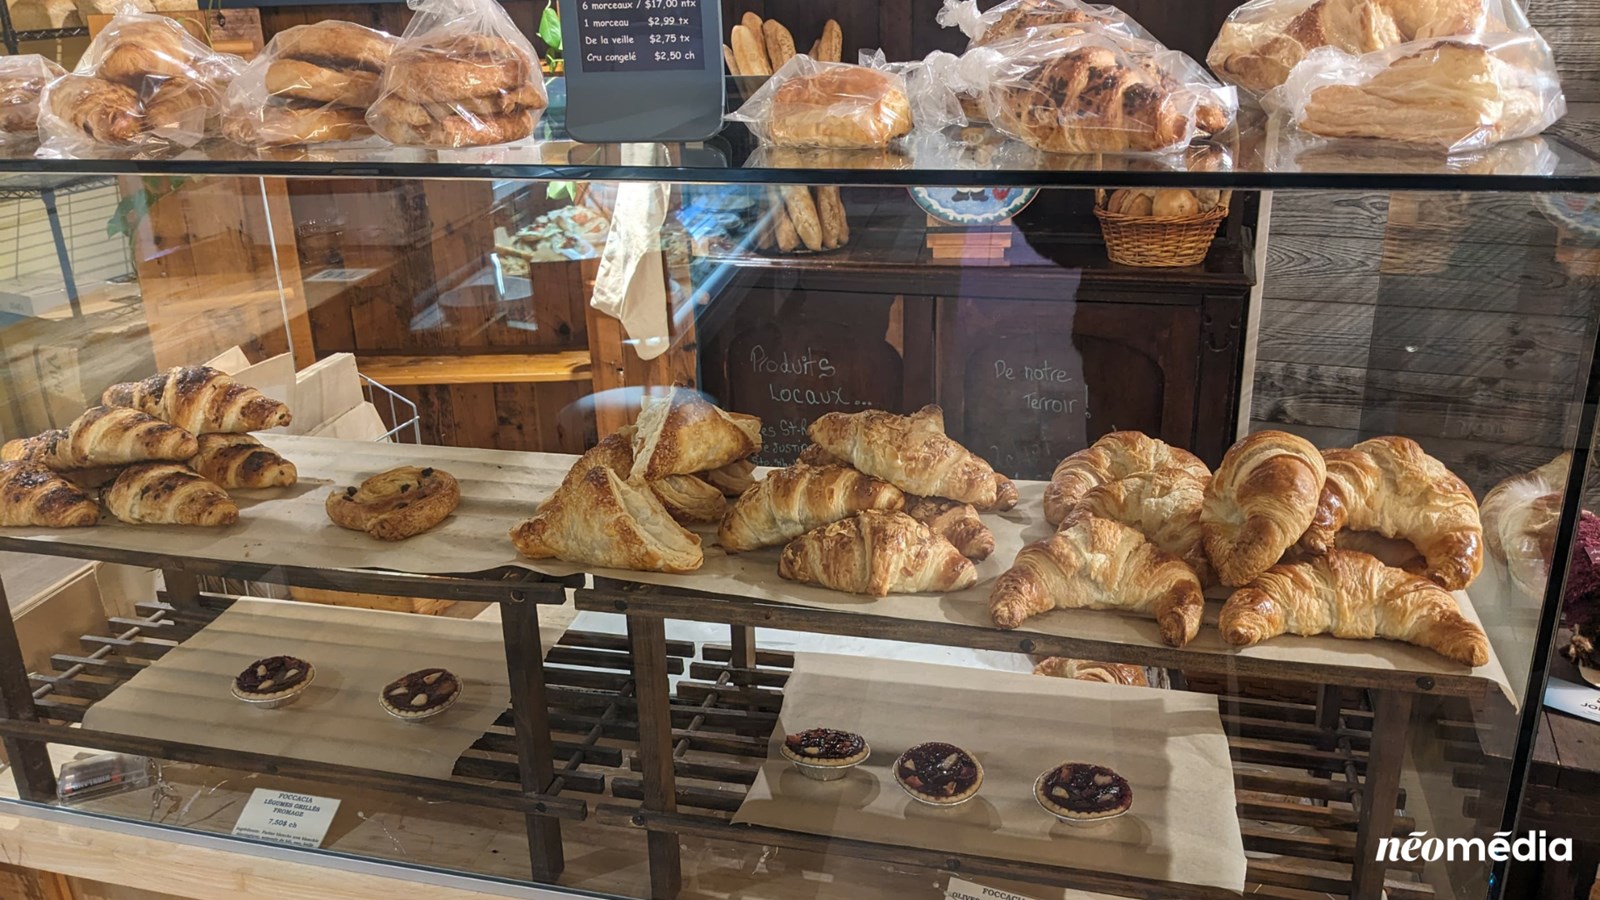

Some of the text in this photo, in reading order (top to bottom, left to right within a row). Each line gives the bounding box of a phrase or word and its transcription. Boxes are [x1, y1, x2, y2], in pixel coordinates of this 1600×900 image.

[582, 1, 589, 10] 6
[591, 2, 633, 10] morceaux
[636, 0, 641, 9] /
[645, 0, 678, 9] $17,00
[584, 16, 689, 28] 1 morceau $2,99 tx
[585, 34, 690, 44] De la veille $2,75 tx
[586, 51, 695, 63] Cru congelé $2,50 ch
[750, 345, 836, 378] Produits
[994, 359, 1073, 382] De notre
[279, 793, 313, 804] FOCCACIA
[264, 799, 320, 812] LÉGUMES GRILLÉS
[273, 807, 304, 817] FROMAGE
[288, 820, 297, 828] ch
